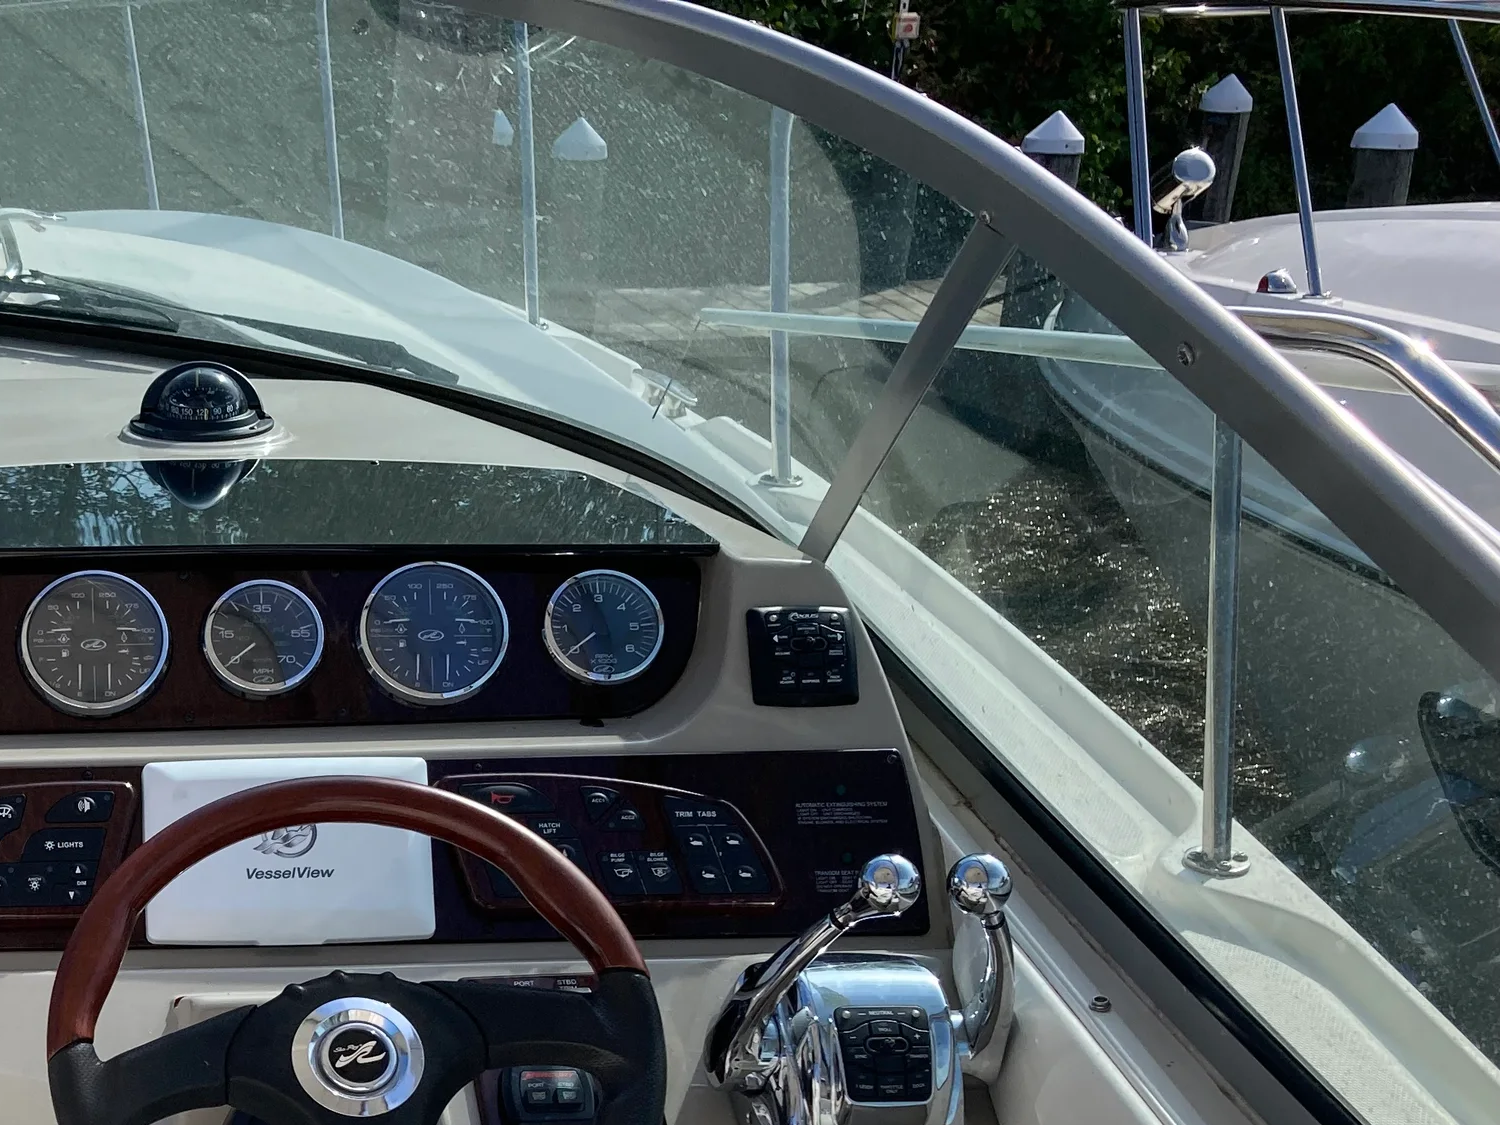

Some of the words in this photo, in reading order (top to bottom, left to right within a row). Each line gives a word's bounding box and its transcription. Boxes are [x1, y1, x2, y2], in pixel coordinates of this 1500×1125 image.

[593, 594, 603, 603] 3
[252, 604, 272, 613] 35
[572, 604, 582, 612] 2
[616, 603, 626, 611] 4
[562, 624, 568, 632] 1
[629, 622, 640, 631] 5
[219, 630, 234, 639] 15
[290, 629, 311, 638] 55
[625, 644, 635, 653] 6
[277, 655, 296, 663] 70
[696, 810, 717, 818] TABS
[246, 867, 335, 880] VesselView
